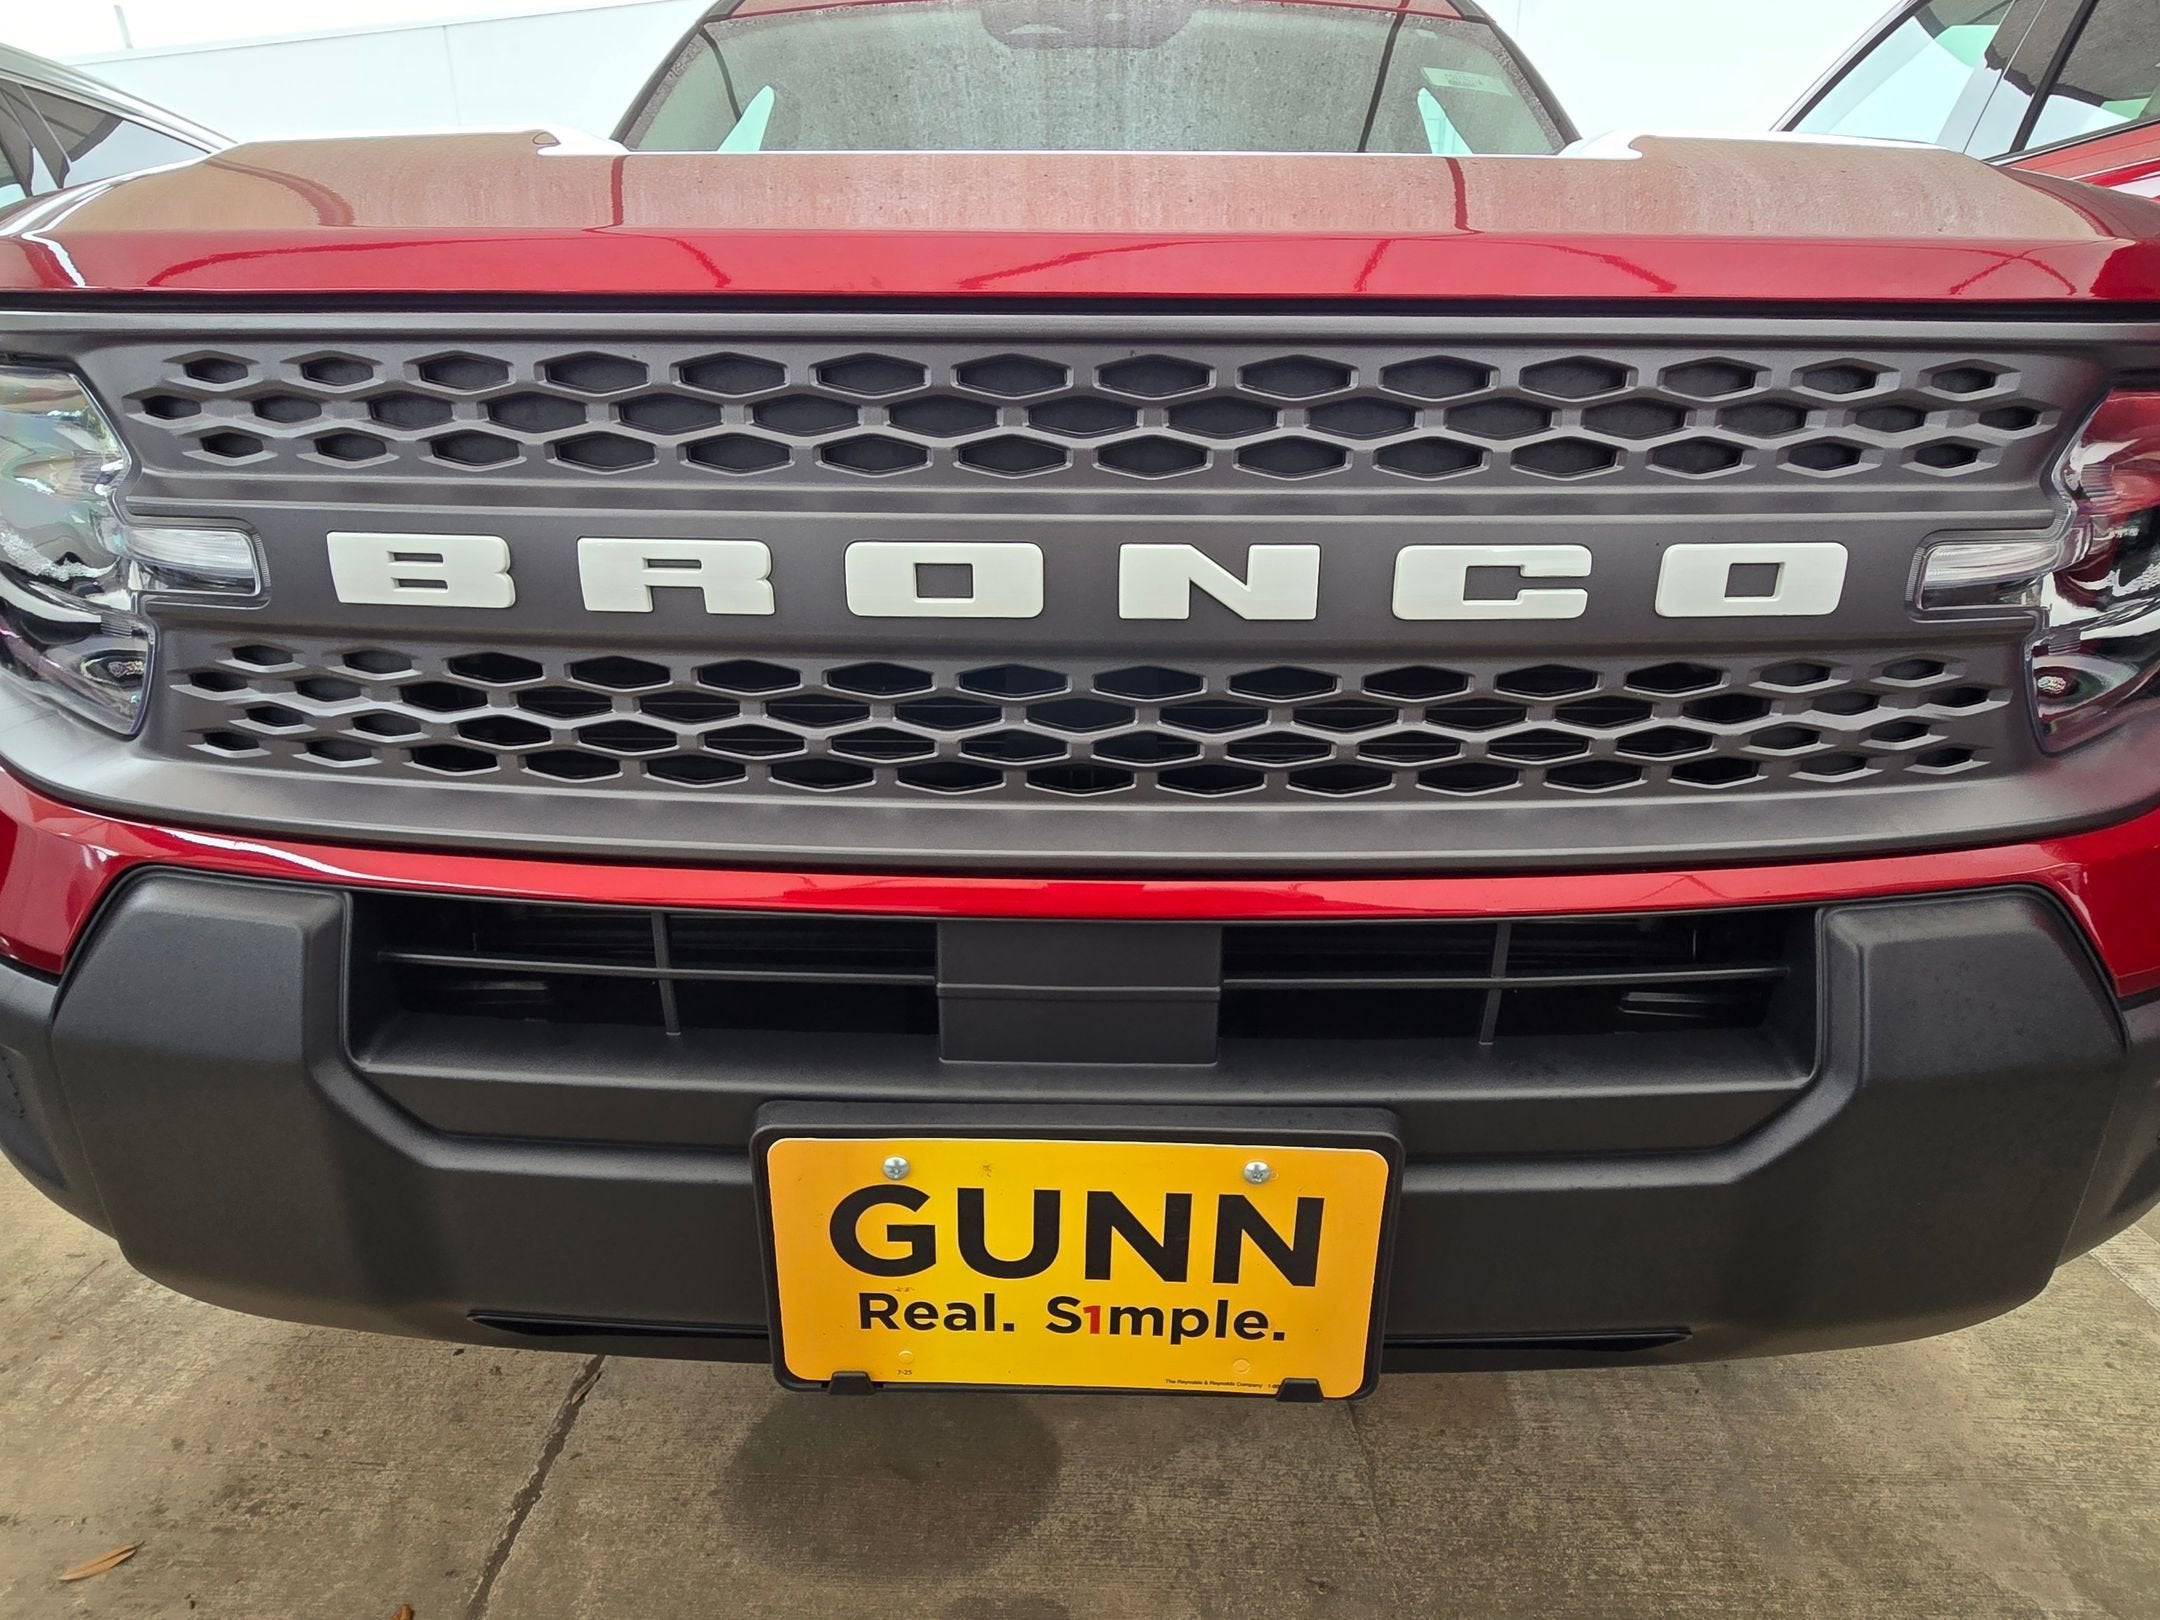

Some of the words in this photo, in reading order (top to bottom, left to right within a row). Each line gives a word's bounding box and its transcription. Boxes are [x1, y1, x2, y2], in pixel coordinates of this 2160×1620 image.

[326, 531, 1849, 620] BRONCO
[829, 1183, 1326, 1288] GUNN
[858, 1292, 1015, 1332] Real.
[1045, 1295, 1287, 1346] S1mple.
